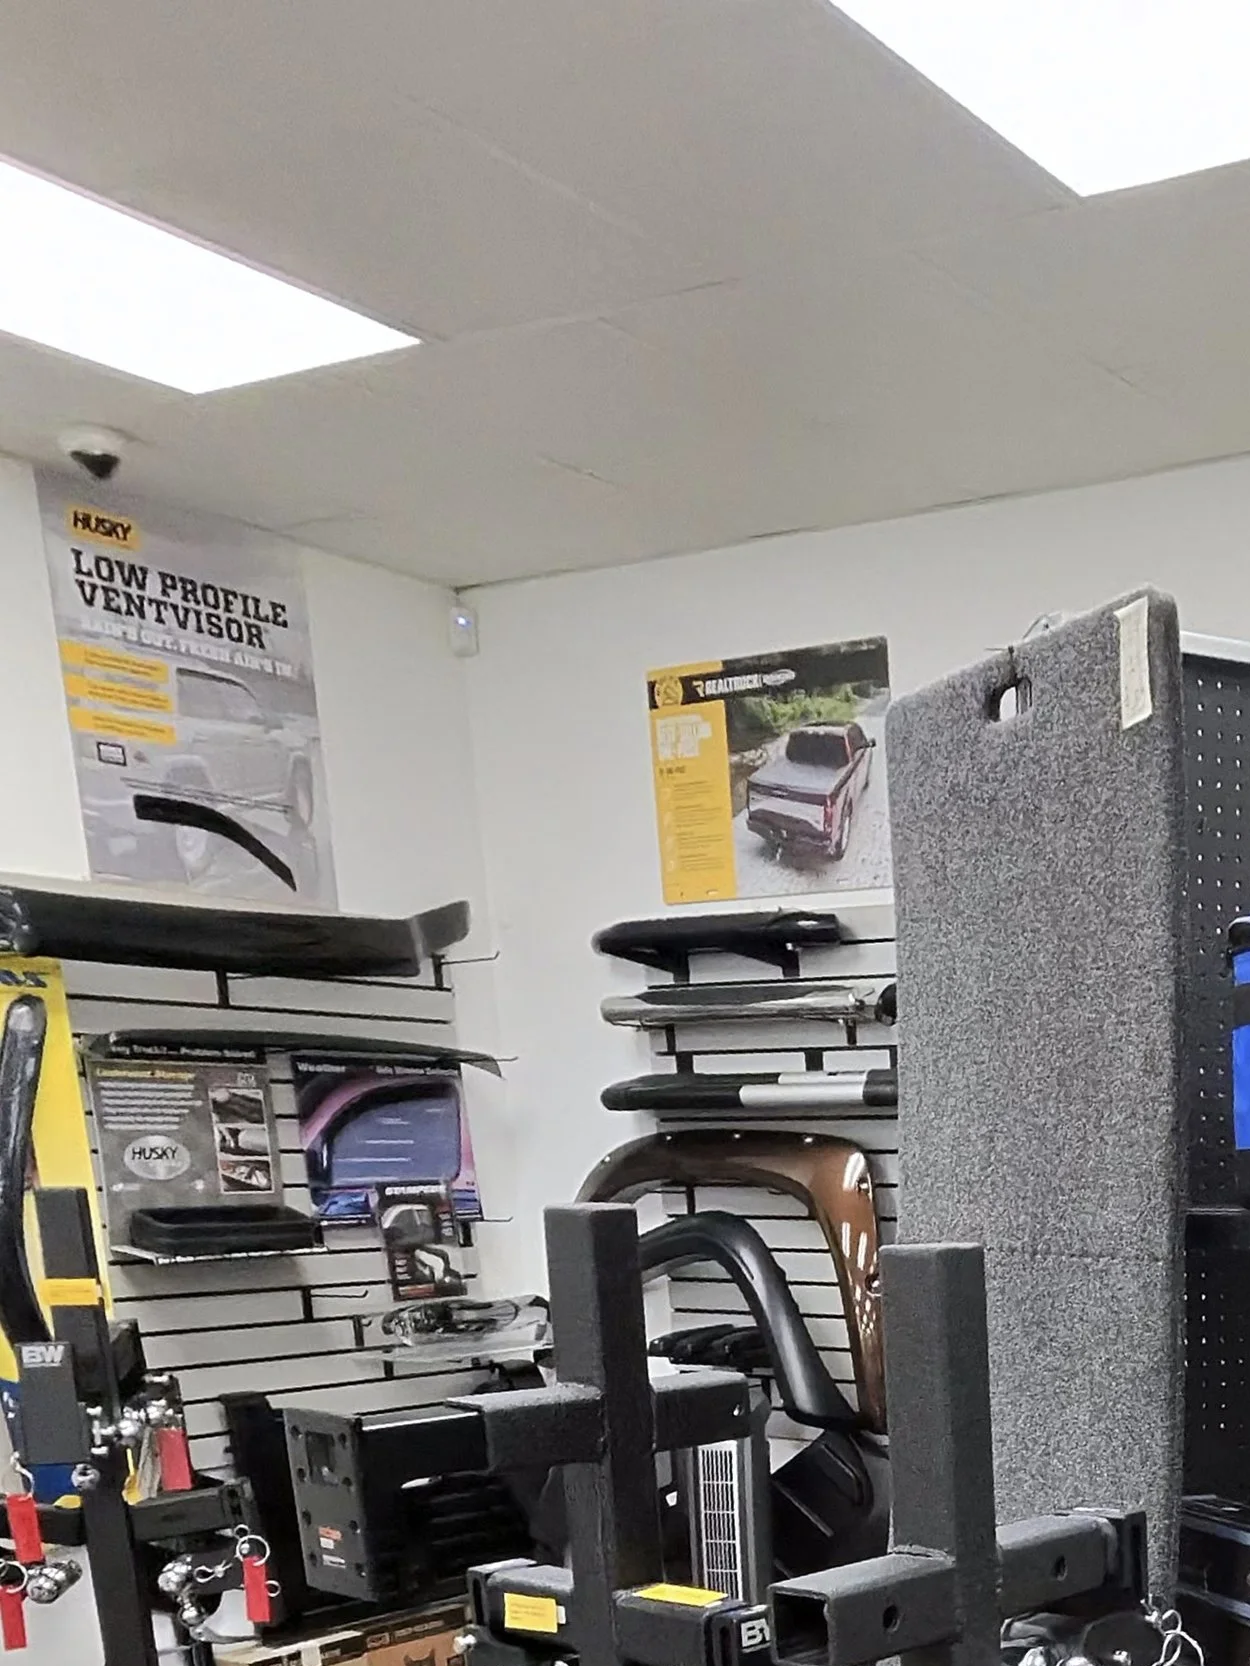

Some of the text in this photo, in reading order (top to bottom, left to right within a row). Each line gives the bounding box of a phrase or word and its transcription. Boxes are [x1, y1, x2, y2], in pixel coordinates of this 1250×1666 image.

[73, 510, 132, 541] HUSKY
[71, 547, 289, 629] LOW PROFILE
[75, 579, 267, 650] VENTVISOR
[131, 1146, 178, 1161] HUSKY
